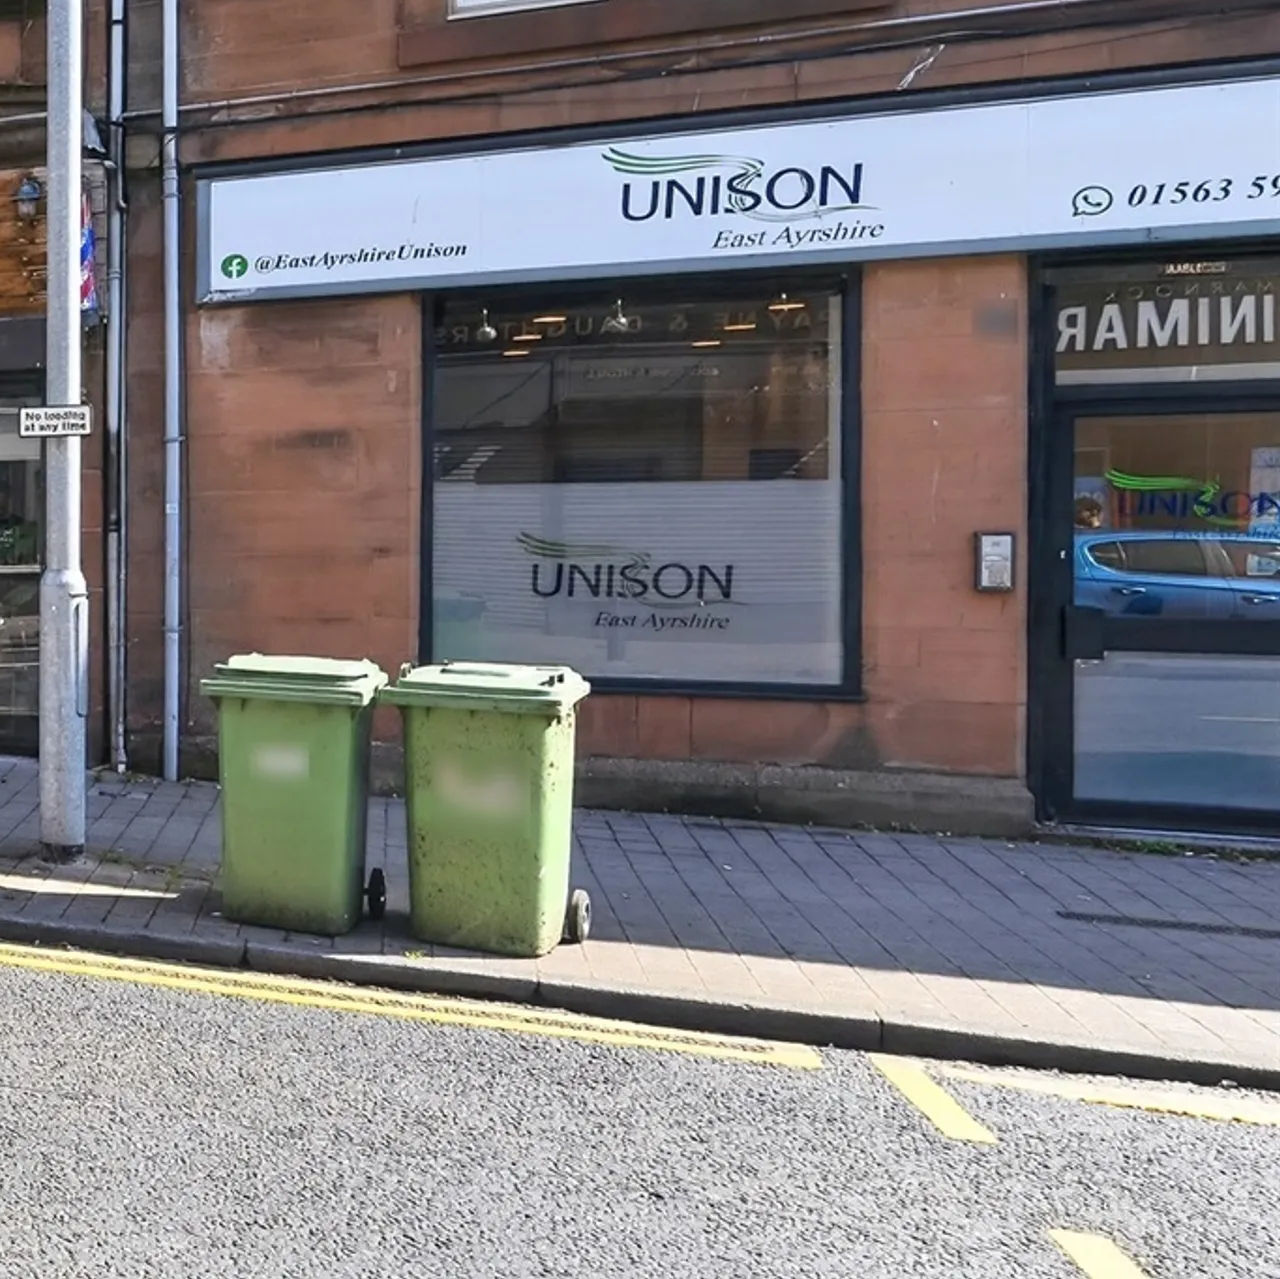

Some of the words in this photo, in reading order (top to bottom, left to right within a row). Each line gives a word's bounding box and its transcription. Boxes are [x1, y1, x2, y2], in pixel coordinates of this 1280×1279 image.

[621, 163, 863, 221] UNISON
[1127, 178, 1233, 207] 01563
[711, 229, 767, 250] East
[771, 219, 885, 249] Ayrshire
[254, 241, 468, 274] @EastAyrshireUnison
[24, 423, 35, 432] at
[39, 424, 58, 432] any
[62, 422, 87, 431] time
[25, 411, 42, 421] No
[44, 410, 86, 421] loading
[532, 563, 734, 600] UNISON
[594, 611, 638, 628] East
[642, 613, 731, 631] Ayrshire
